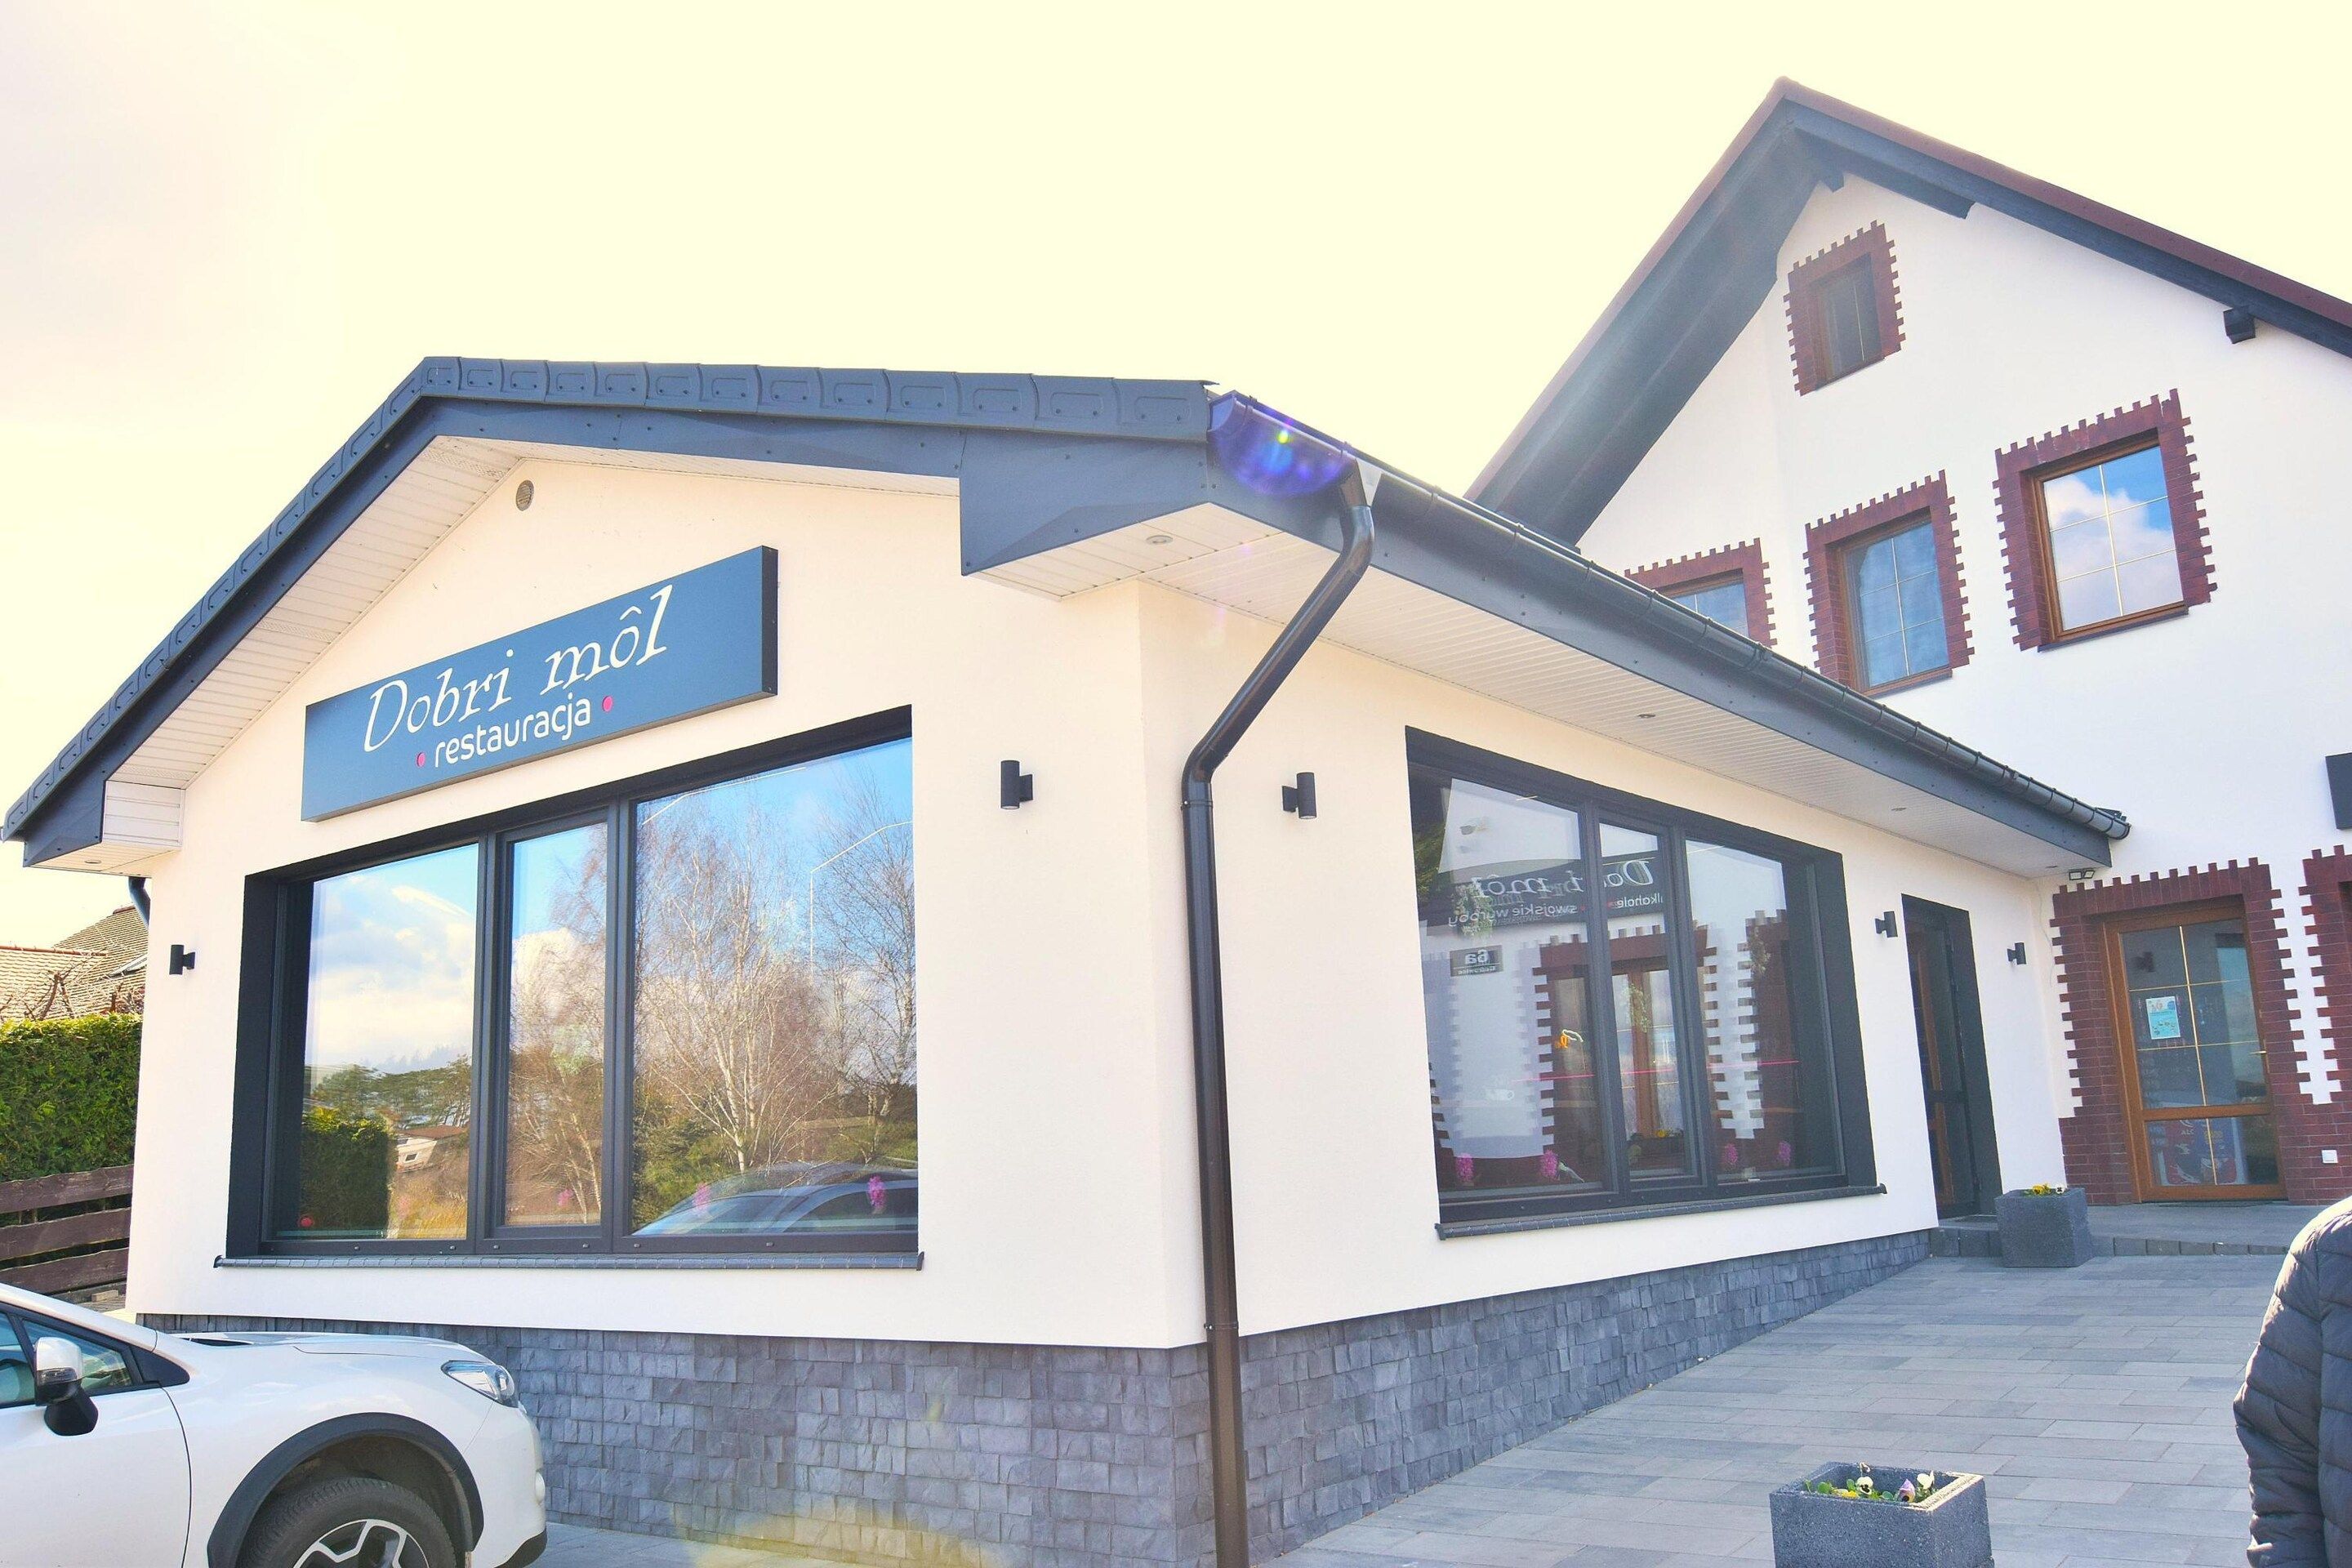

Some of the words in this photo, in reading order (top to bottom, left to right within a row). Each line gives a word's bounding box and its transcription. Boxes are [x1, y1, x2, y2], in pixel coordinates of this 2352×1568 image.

[364, 649, 514, 752] Dobri
[540, 584, 674, 695] môl
[435, 692, 592, 768] restauracja
